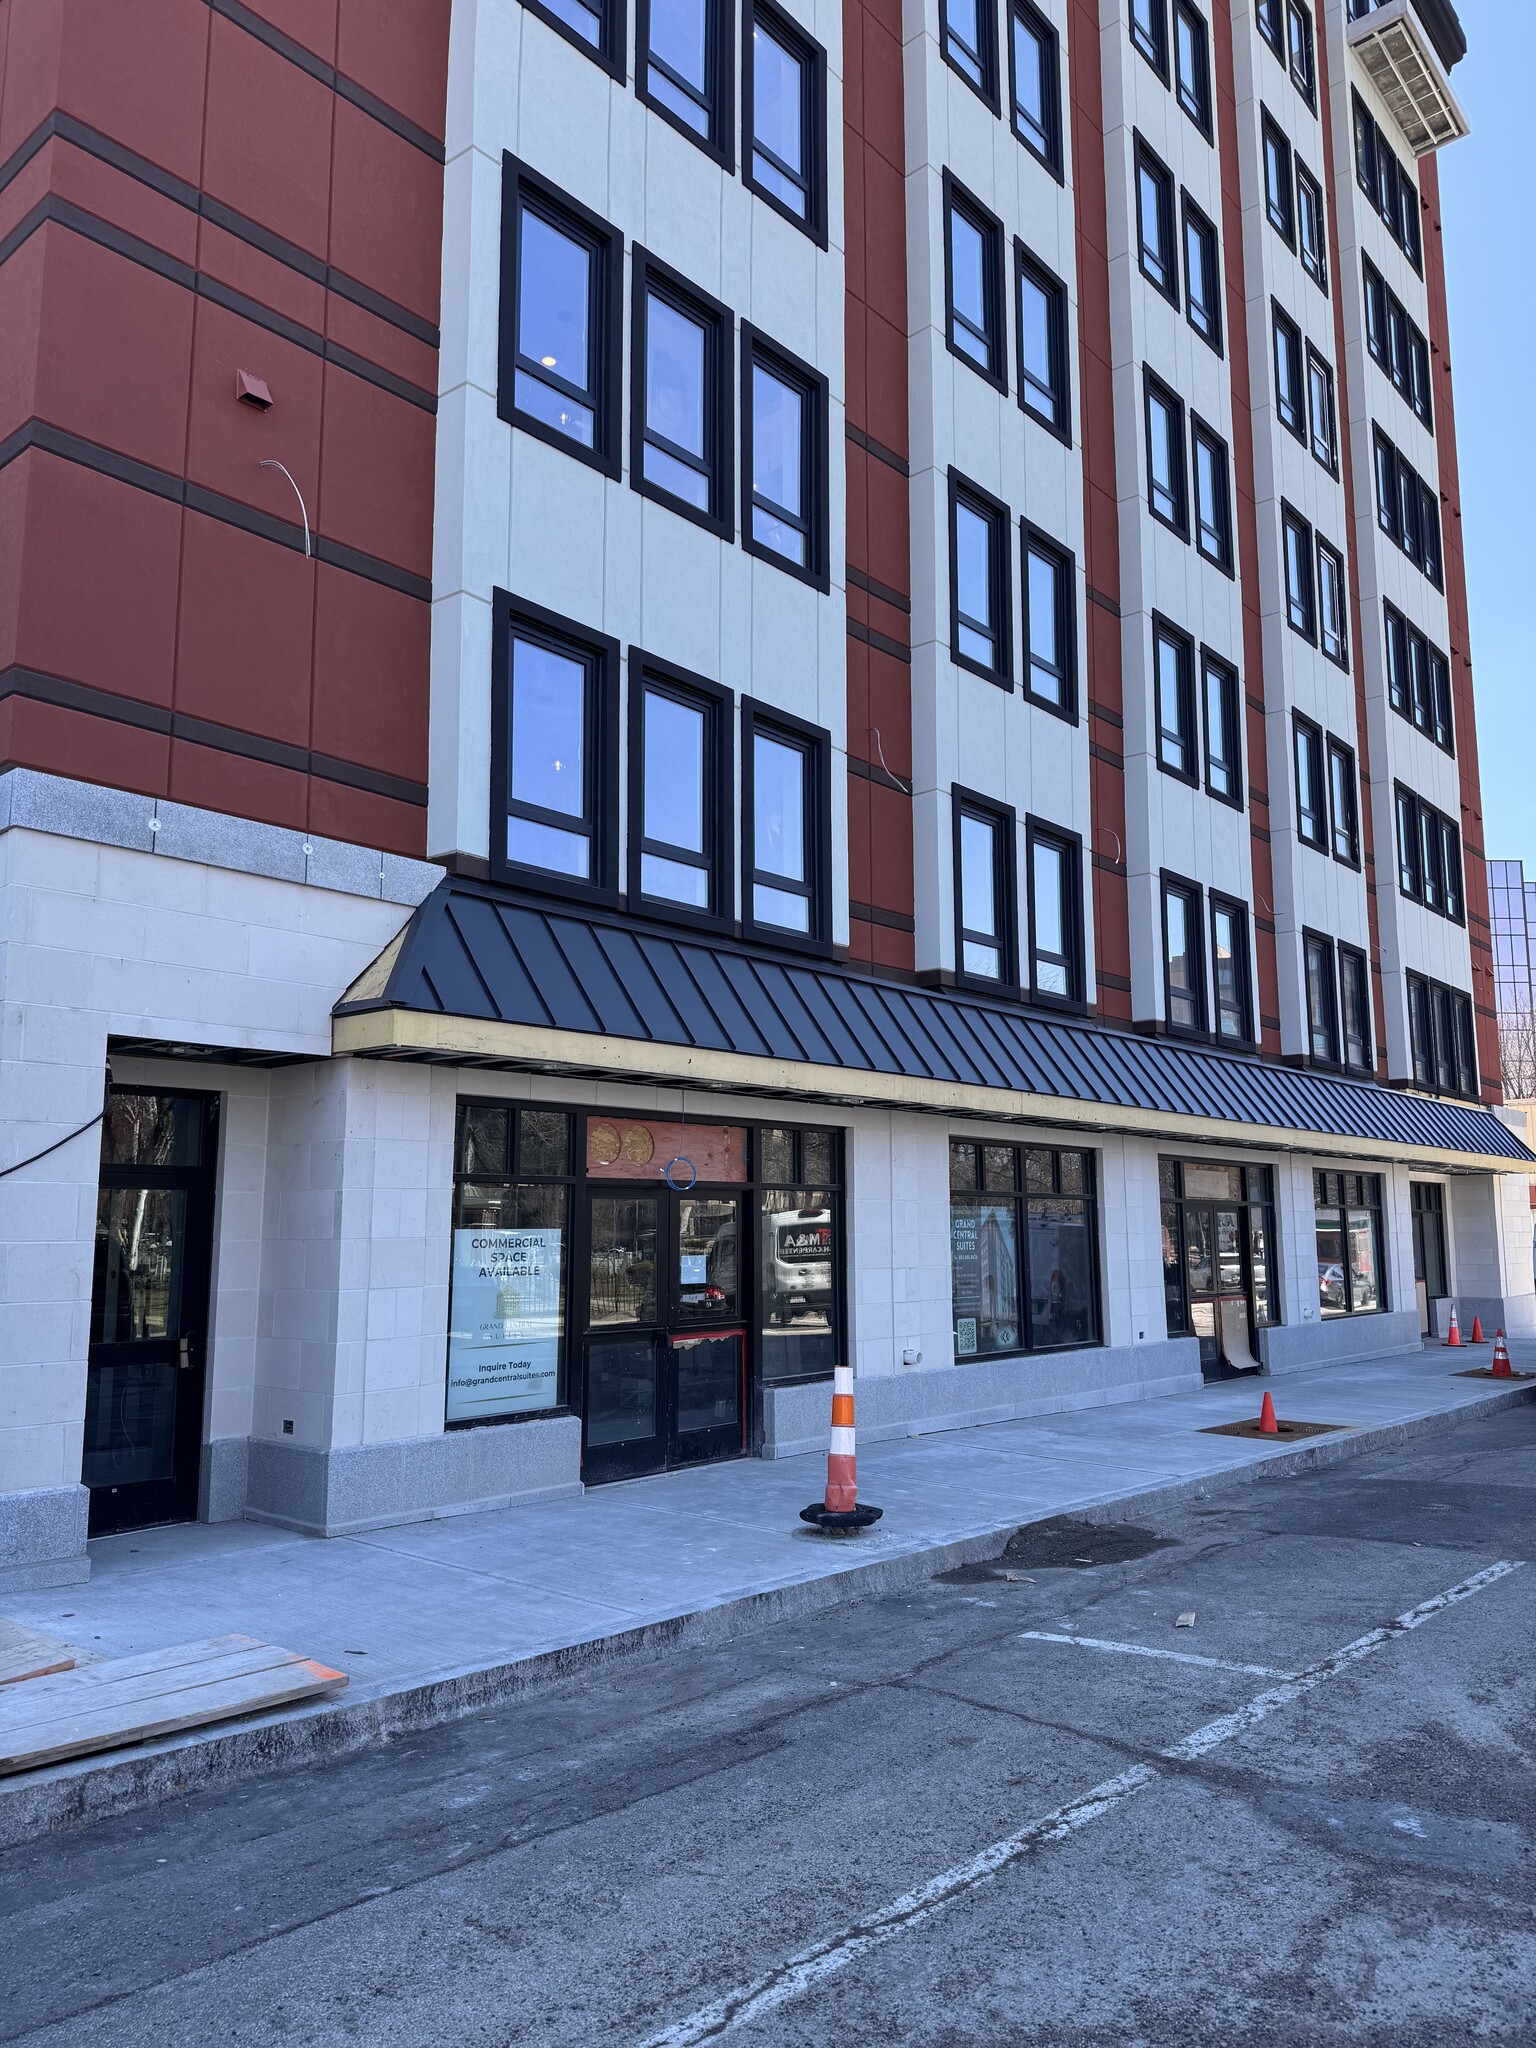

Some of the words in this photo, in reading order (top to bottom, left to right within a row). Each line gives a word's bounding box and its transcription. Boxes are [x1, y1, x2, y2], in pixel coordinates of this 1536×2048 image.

[955, 1219, 976, 1229] GRAND
[953, 1230, 978, 1240] CENTRAL
[471, 1237, 546, 1249] COMMERCIAL
[956, 1241, 976, 1251] SUITES
[490, 1252, 527, 1263] SPACE
[478, 1266, 540, 1278] AVAILABLE
[479, 1322, 504, 1331] GRAND
[478, 1362, 507, 1373] Inquire
[508, 1360, 532, 1371] Today
[450, 1370, 556, 1388] info@grandcentralsuites.com
